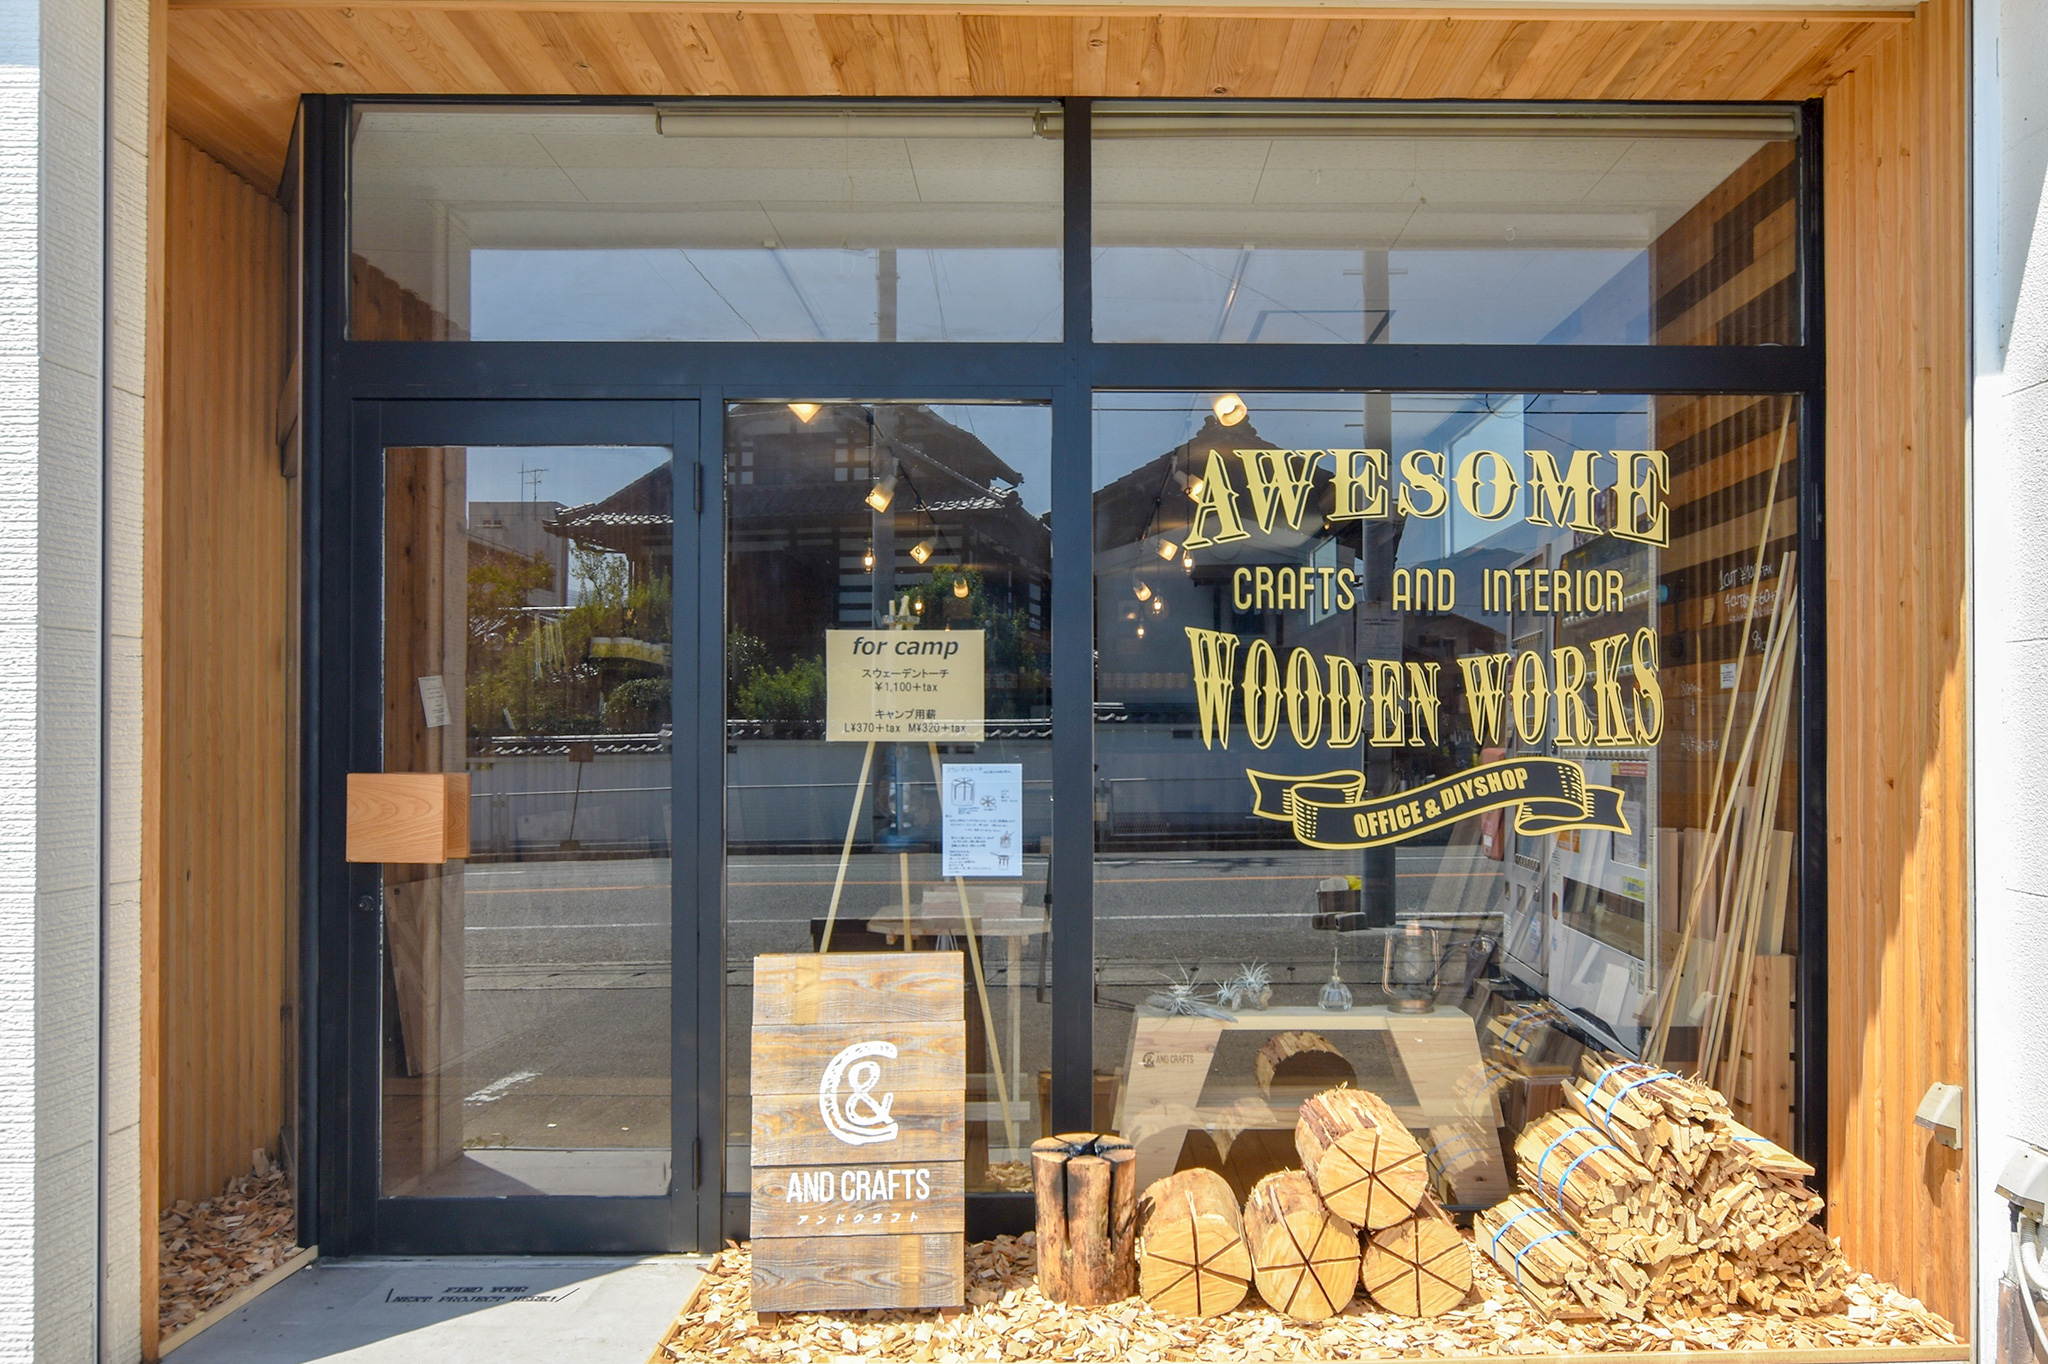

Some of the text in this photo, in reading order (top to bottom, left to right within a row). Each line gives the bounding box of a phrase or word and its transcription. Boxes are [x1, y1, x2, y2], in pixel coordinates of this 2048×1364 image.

[1182, 448, 1670, 549] AWESOME
[1233, 566, 1625, 614] CRAFTS AND INTERIOR
[852, 636, 959, 659] for camp
[862, 668, 949, 678] スウェーデントーチ
[874, 681, 938, 693] ¥1,100+tax
[1184, 626, 1665, 751] WOODEN WORKS
[875, 709, 936, 720] キャンプ用薪
[844, 723, 966, 733] L¥370+tax M¥320+tax
[1353, 767, 1528, 838] OFFICE & DIYSHOP
[1156, 1055, 1194, 1064] AND CRAFTS
[787, 1168, 930, 1203] AND CRAFTS
[797, 1212, 919, 1225] アンドクラフト
